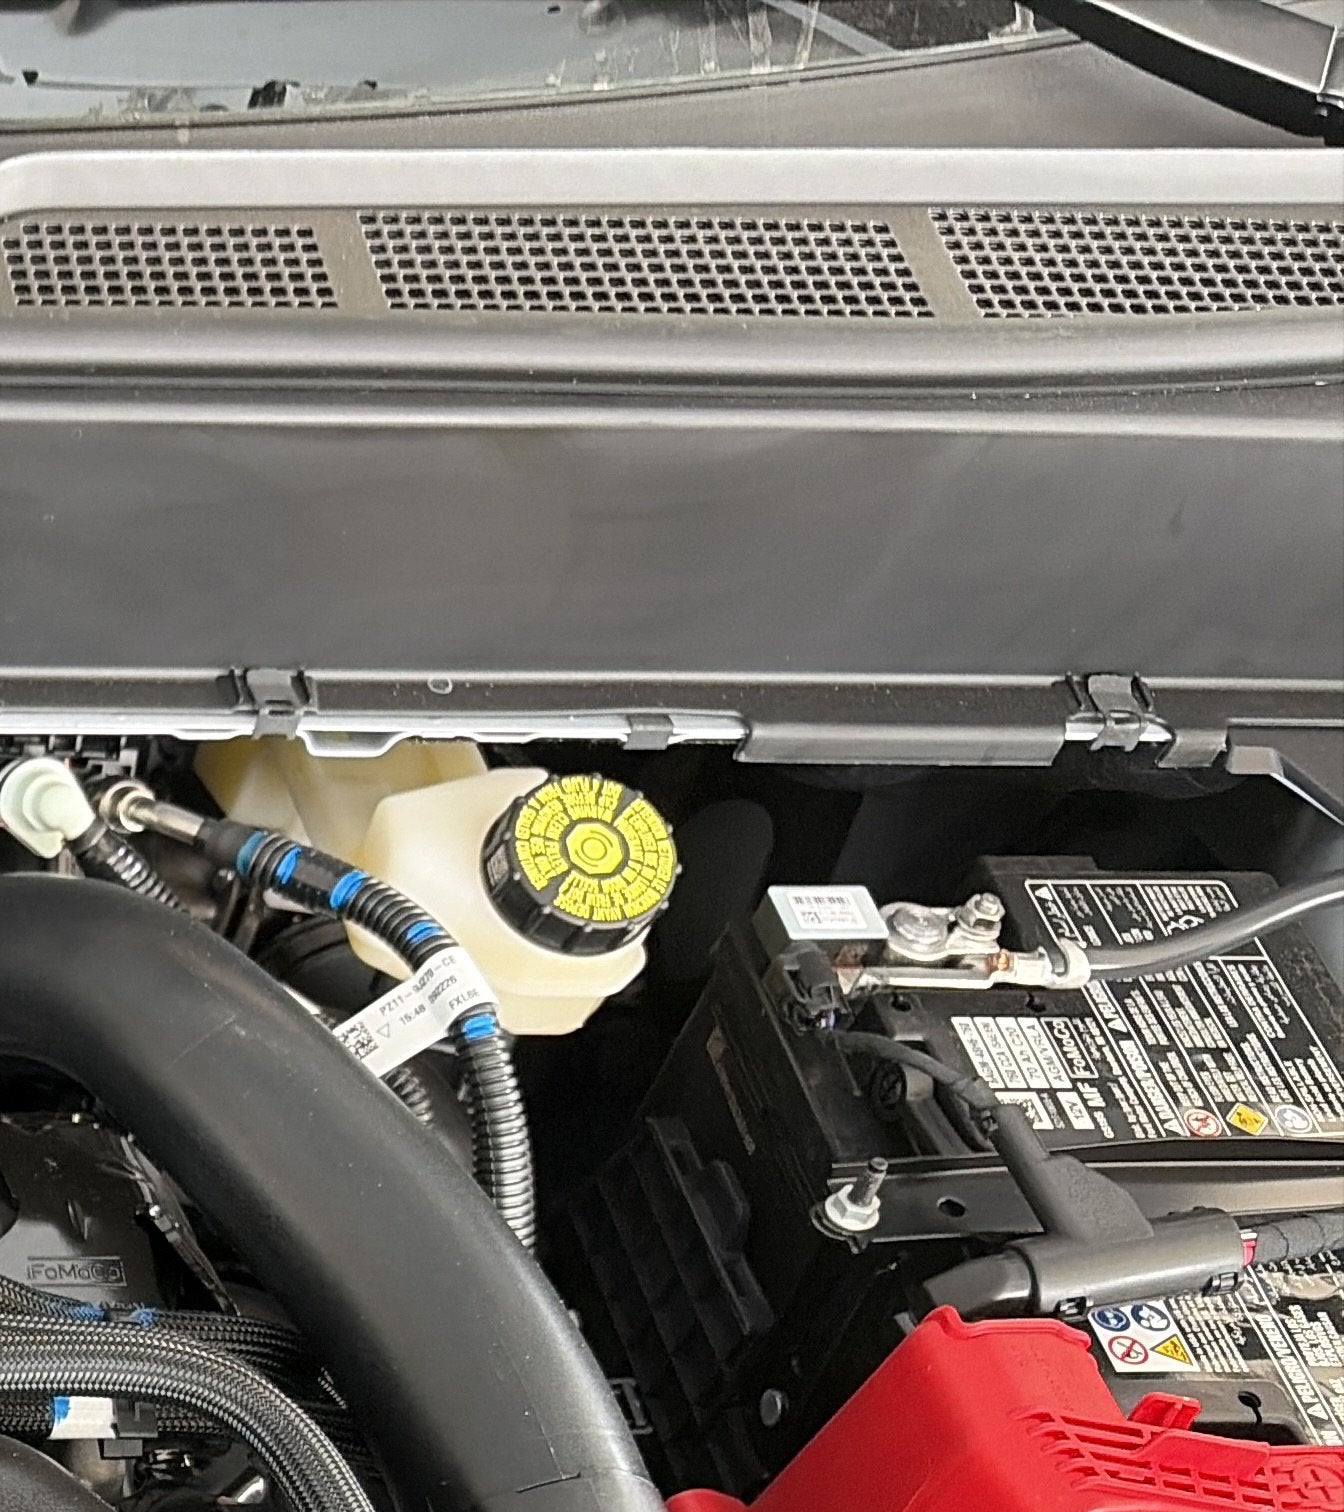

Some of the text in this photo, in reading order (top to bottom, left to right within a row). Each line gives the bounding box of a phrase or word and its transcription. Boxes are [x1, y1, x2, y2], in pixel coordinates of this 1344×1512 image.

[1052, 1019, 1091, 1076] FoMoCo
[32, 1263, 120, 1280] FoMoCo
[1255, 1314, 1318, 1404] PELIGRO/VENENO
